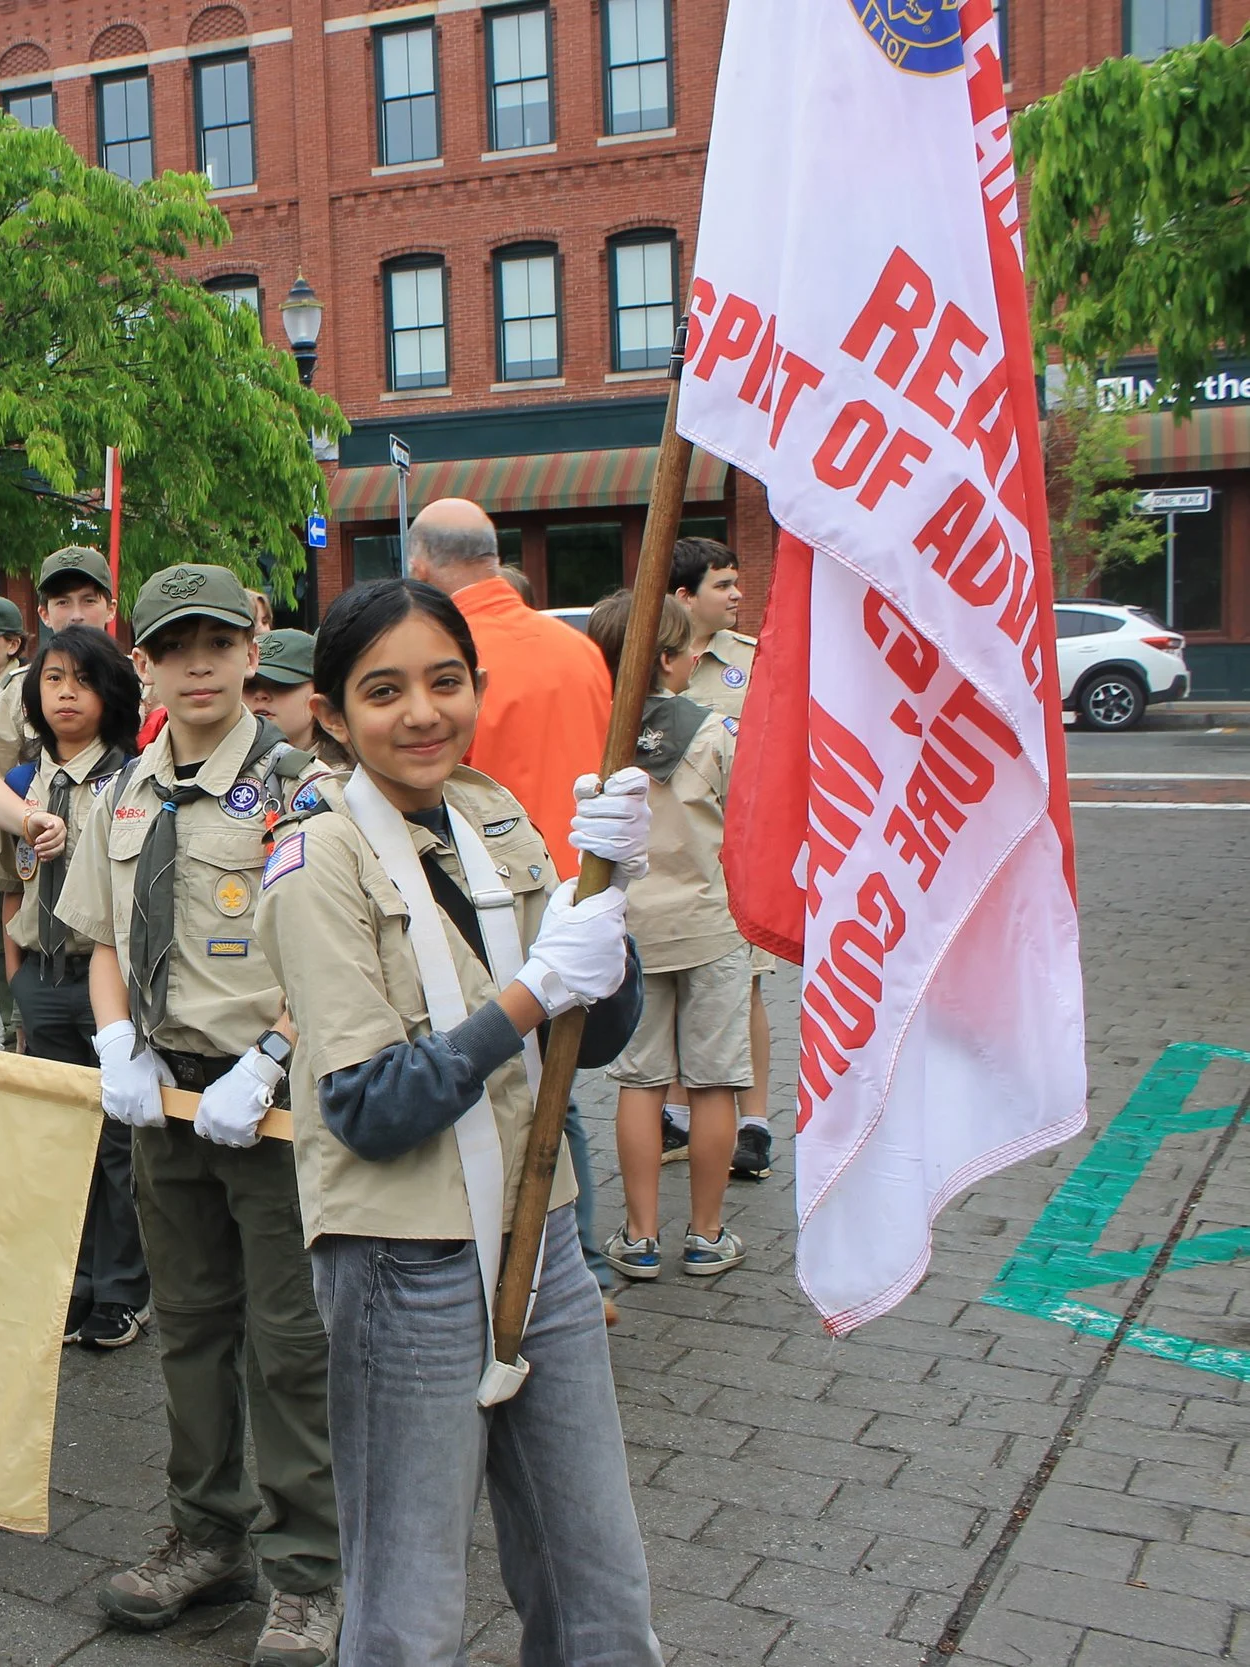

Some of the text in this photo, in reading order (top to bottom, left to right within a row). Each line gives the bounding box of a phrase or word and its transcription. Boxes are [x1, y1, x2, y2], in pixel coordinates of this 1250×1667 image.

[840, 245, 1034, 535] REA
[812, 398, 933, 512] OF
[127, 808, 146, 818] BSA
